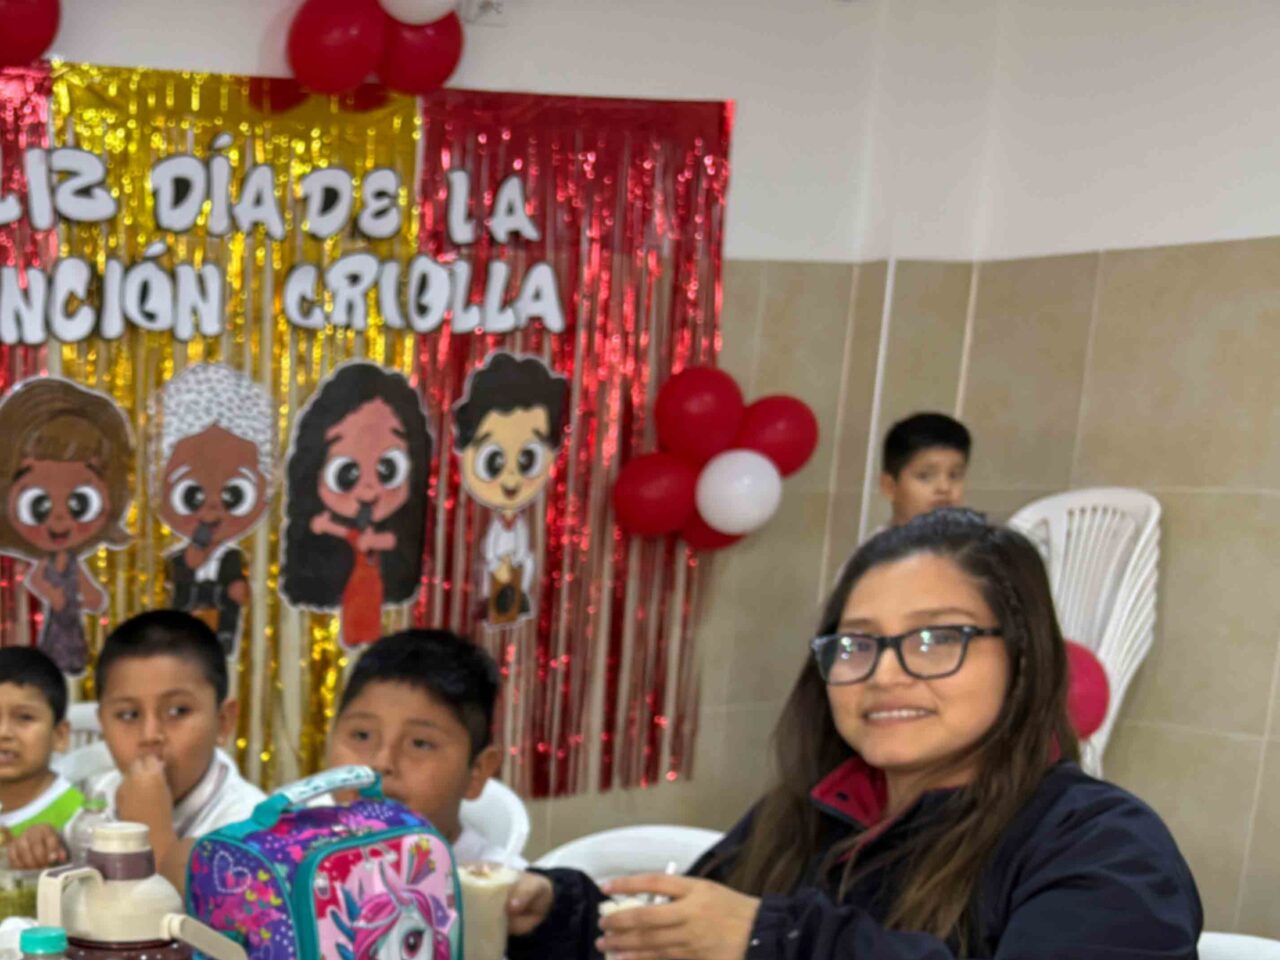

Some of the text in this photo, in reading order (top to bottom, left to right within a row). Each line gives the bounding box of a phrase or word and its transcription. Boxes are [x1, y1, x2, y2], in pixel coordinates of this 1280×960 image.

[151, 134, 284, 239] DÍA
[301, 168, 400, 238] DE
[448, 169, 540, 244] LA
[284, 253, 564, 334] CRIOLLA
